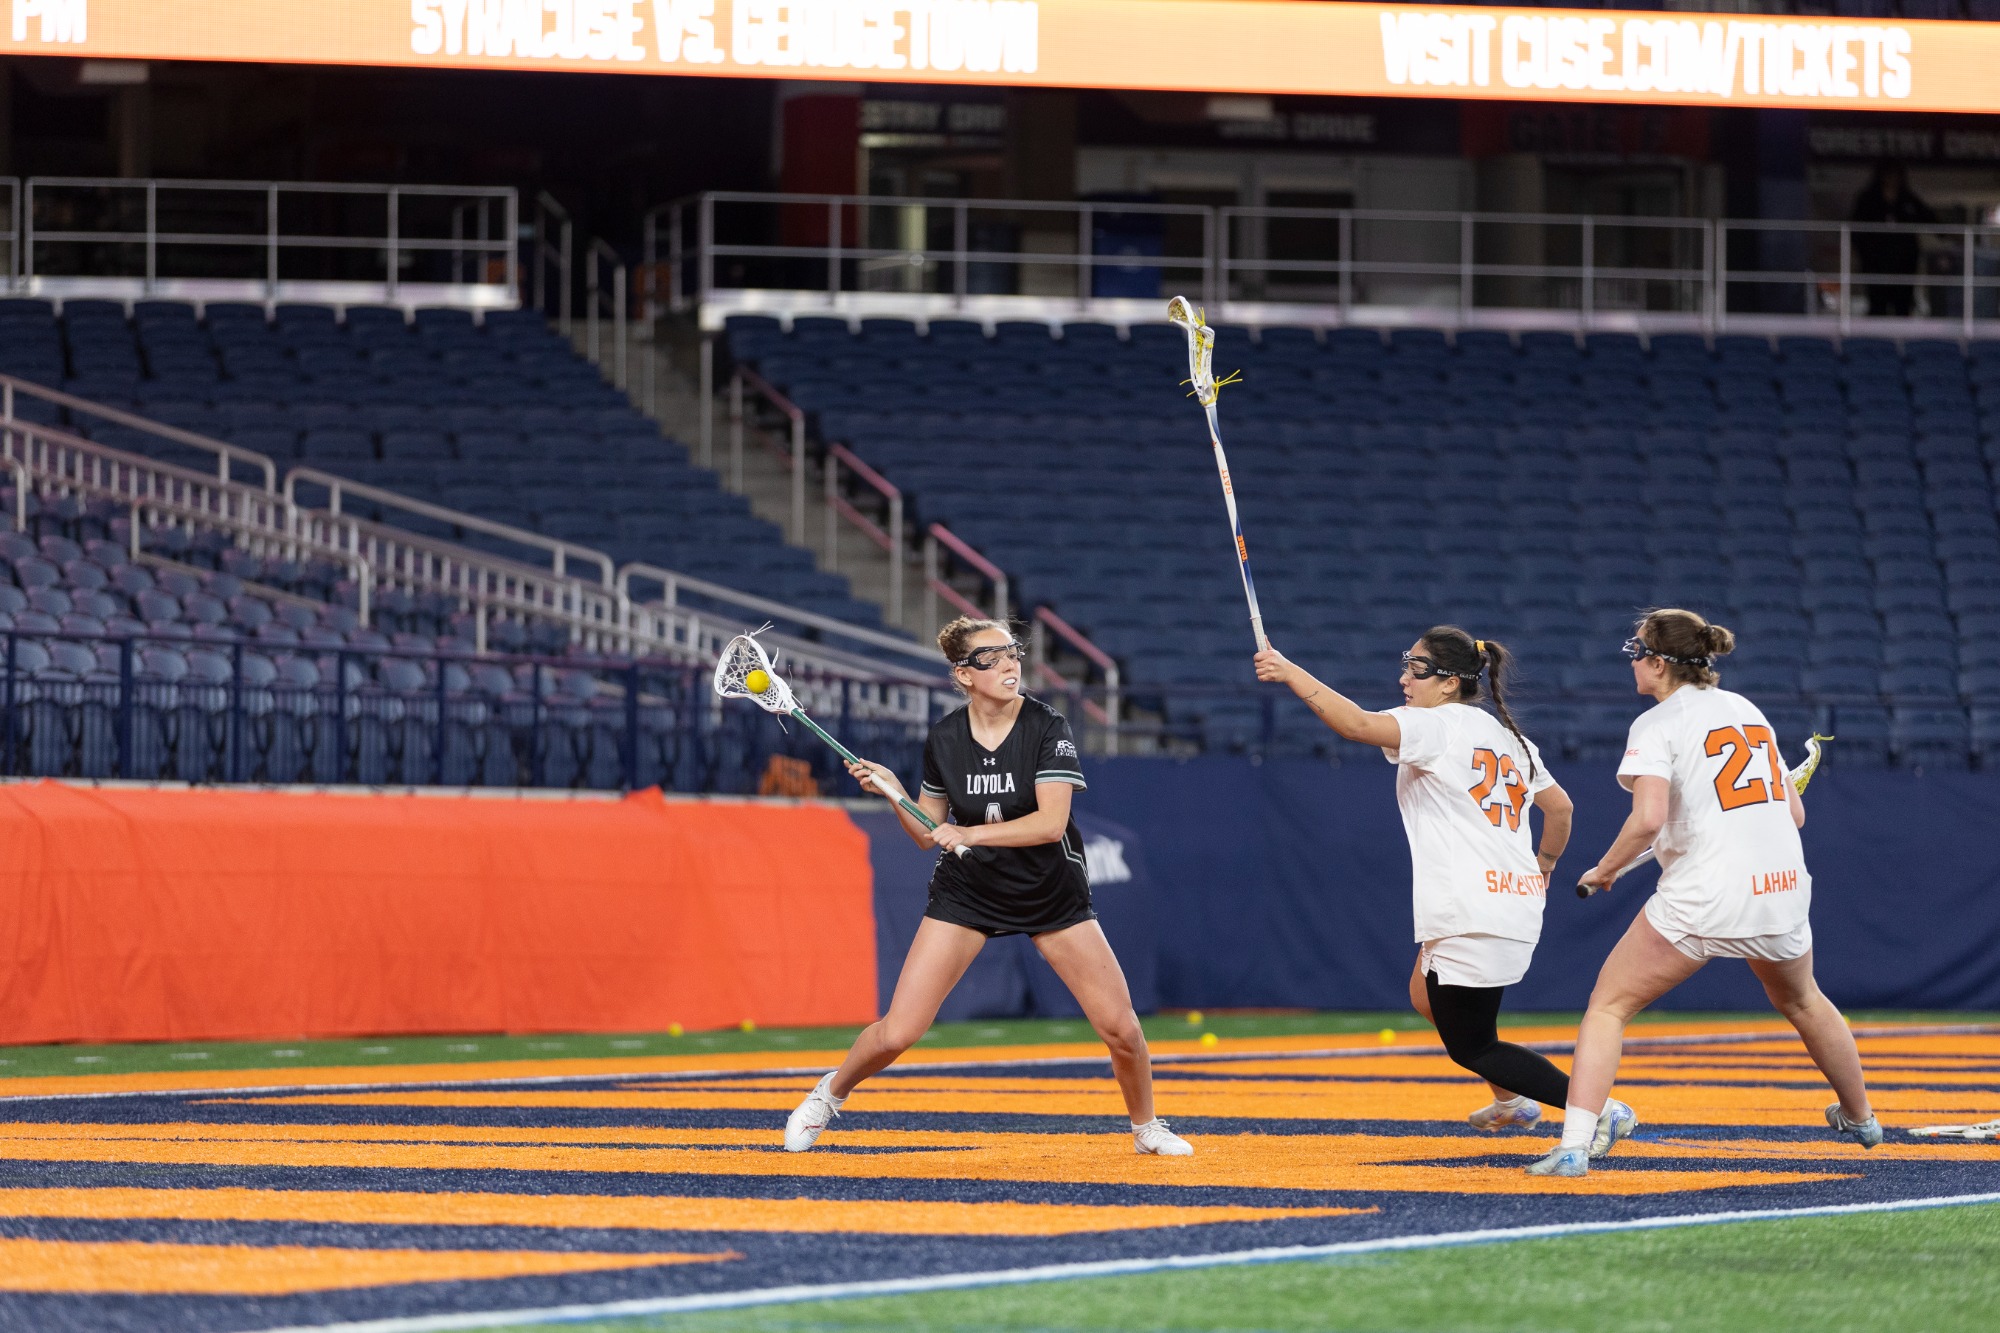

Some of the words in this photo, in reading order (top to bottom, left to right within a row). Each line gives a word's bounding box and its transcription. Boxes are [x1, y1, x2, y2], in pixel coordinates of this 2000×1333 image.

[12, 0, 87, 43] PM
[410, 0, 646, 62] SYRACUSE
[653, 0, 726, 64] VS.
[732, 0, 1038, 73] GEORGETOWN
[1380, 12, 1496, 87] VISIT
[1501, 16, 1912, 99] CUSE.COM/TICKETS
[966, 772, 1015, 795] LOYOLA
[1468, 747, 1529, 833] 23
[1704, 723, 1786, 812] 27
[1752, 869, 1798, 896] LAHAH
